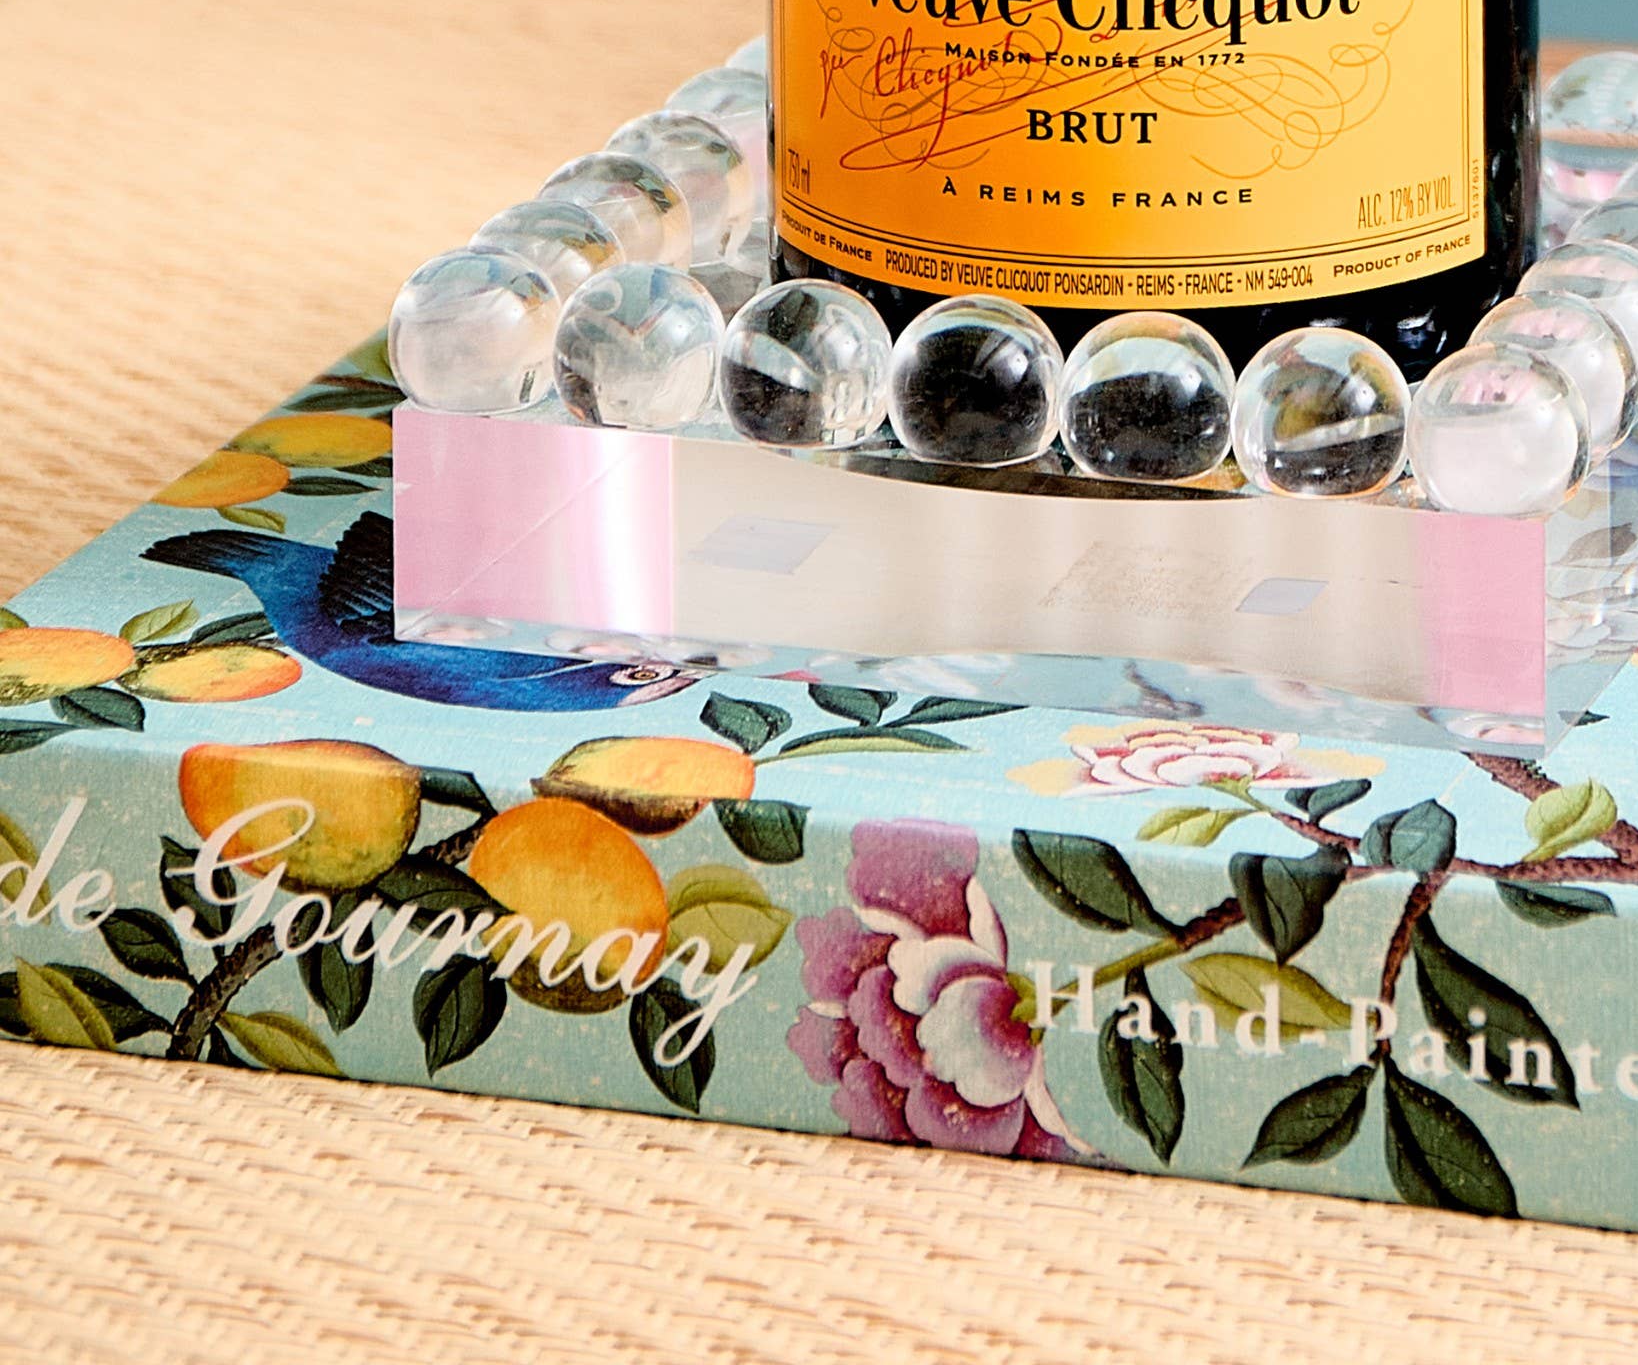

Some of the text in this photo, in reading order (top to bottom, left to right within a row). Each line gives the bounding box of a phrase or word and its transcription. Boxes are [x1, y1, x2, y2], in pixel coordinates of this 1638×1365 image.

[1155, 55, 1183, 68] EN
[1198, 52, 1246, 66] 1772
[1025, 108, 1158, 144] BRUT
[801, 159, 810, 196] ml
[942, 175, 1253, 208] À REIMS FRANCE
[1358, 174, 1457, 230] ALC. 12% BY VOL.
[782, 209, 873, 262] PRODUIT DE FRANCE
[1333, 234, 1472, 278] PRODUCT OF FRANCE
[885, 248, 1314, 297] PRODUCED BY VEUVE CLICQUOT PONSARDIN REIMS FRANCE NM 549-004
[0, 797, 768, 1068] de Gournay
